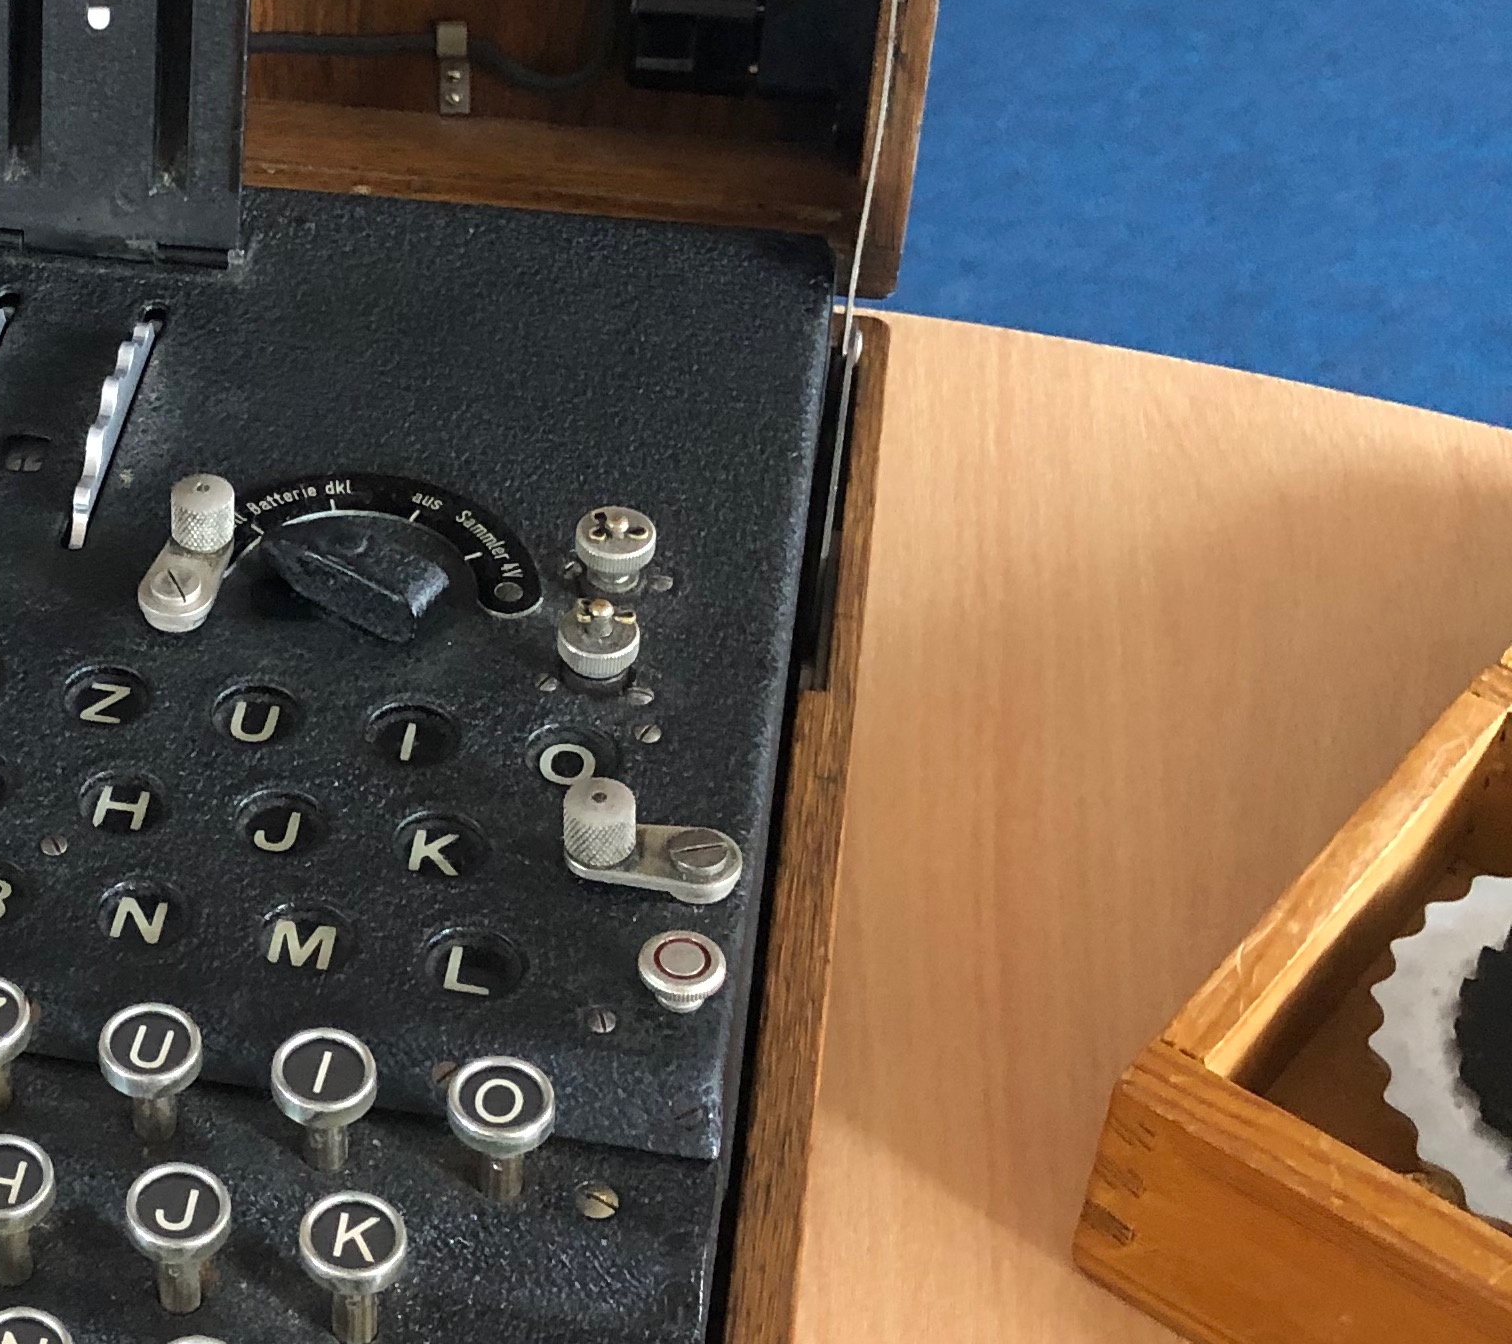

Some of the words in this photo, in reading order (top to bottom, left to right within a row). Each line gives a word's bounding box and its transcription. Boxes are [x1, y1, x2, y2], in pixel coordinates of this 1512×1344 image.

[246, 486, 317, 516] Batterie
[325, 479, 352, 495] dkl
[411, 492, 443, 510] aus
[455, 509, 510, 560] Sammler
[500, 562, 524, 578] 4V
[79, 681, 131, 724] Z
[230, 699, 280, 743] U
[399, 722, 417, 761] I
[538, 742, 597, 787] O
[92, 784, 150, 830] H
[253, 811, 301, 852] J
[408, 829, 459, 876] K
[109, 896, 168, 944] N
[266, 918, 337, 970] M
[443, 945, 490, 995] L
[129, 1024, 175, 1069] U
[312, 1050, 333, 1094] I
[474, 1078, 524, 1124] O
[154, 1188, 200, 1231] J
[332, 1212, 381, 1263] K
